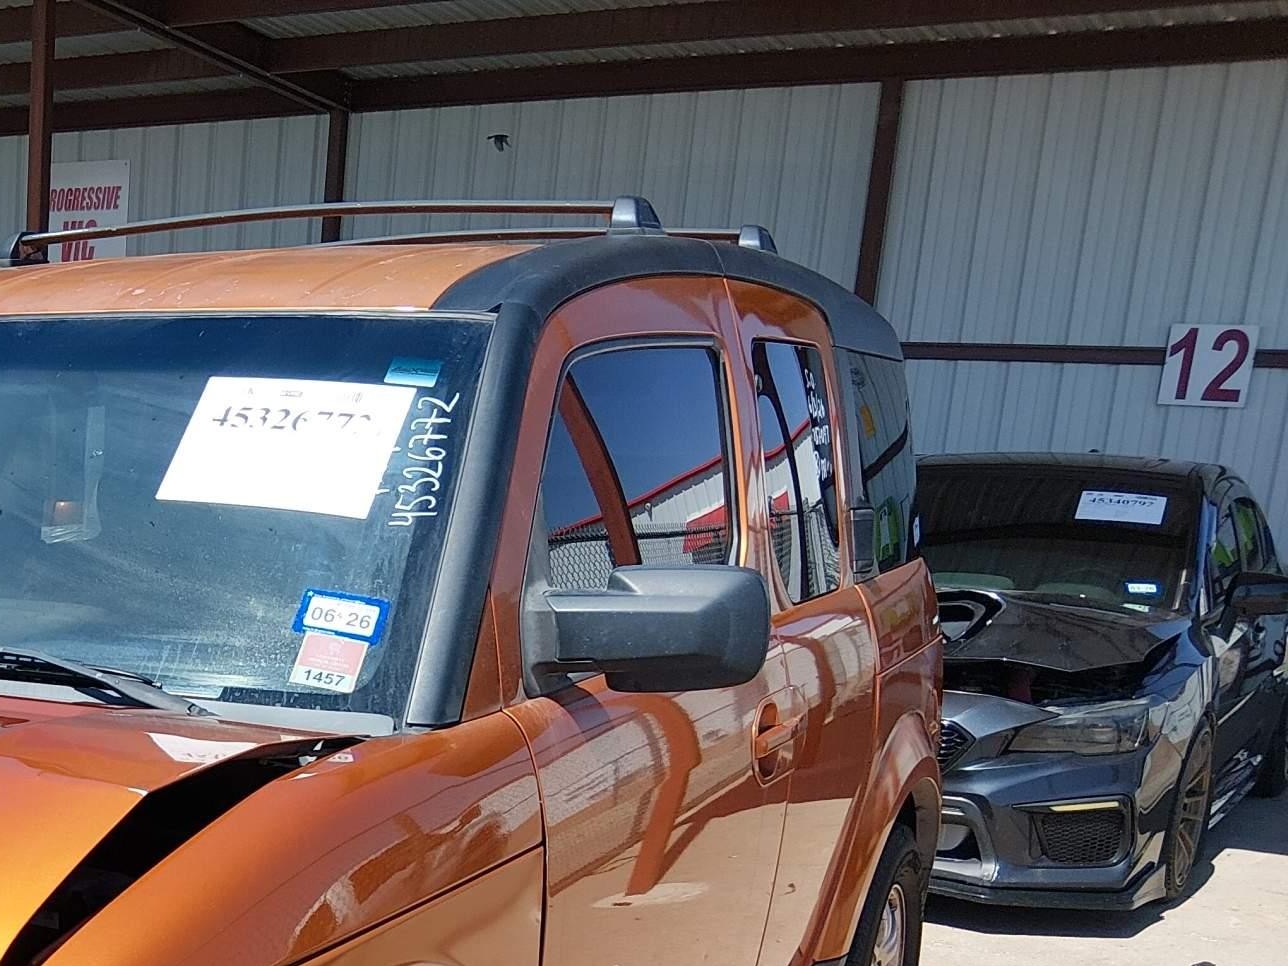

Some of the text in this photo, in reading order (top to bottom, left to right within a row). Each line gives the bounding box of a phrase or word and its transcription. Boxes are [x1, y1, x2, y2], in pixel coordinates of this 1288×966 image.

[50, 186, 122, 212] ROGRESSIVE
[1169, 327, 1250, 403] 12
[388, 392, 460, 526] 45326772
[311, 606, 372, 629] 06 26
[304, 669, 345, 686] 1457
